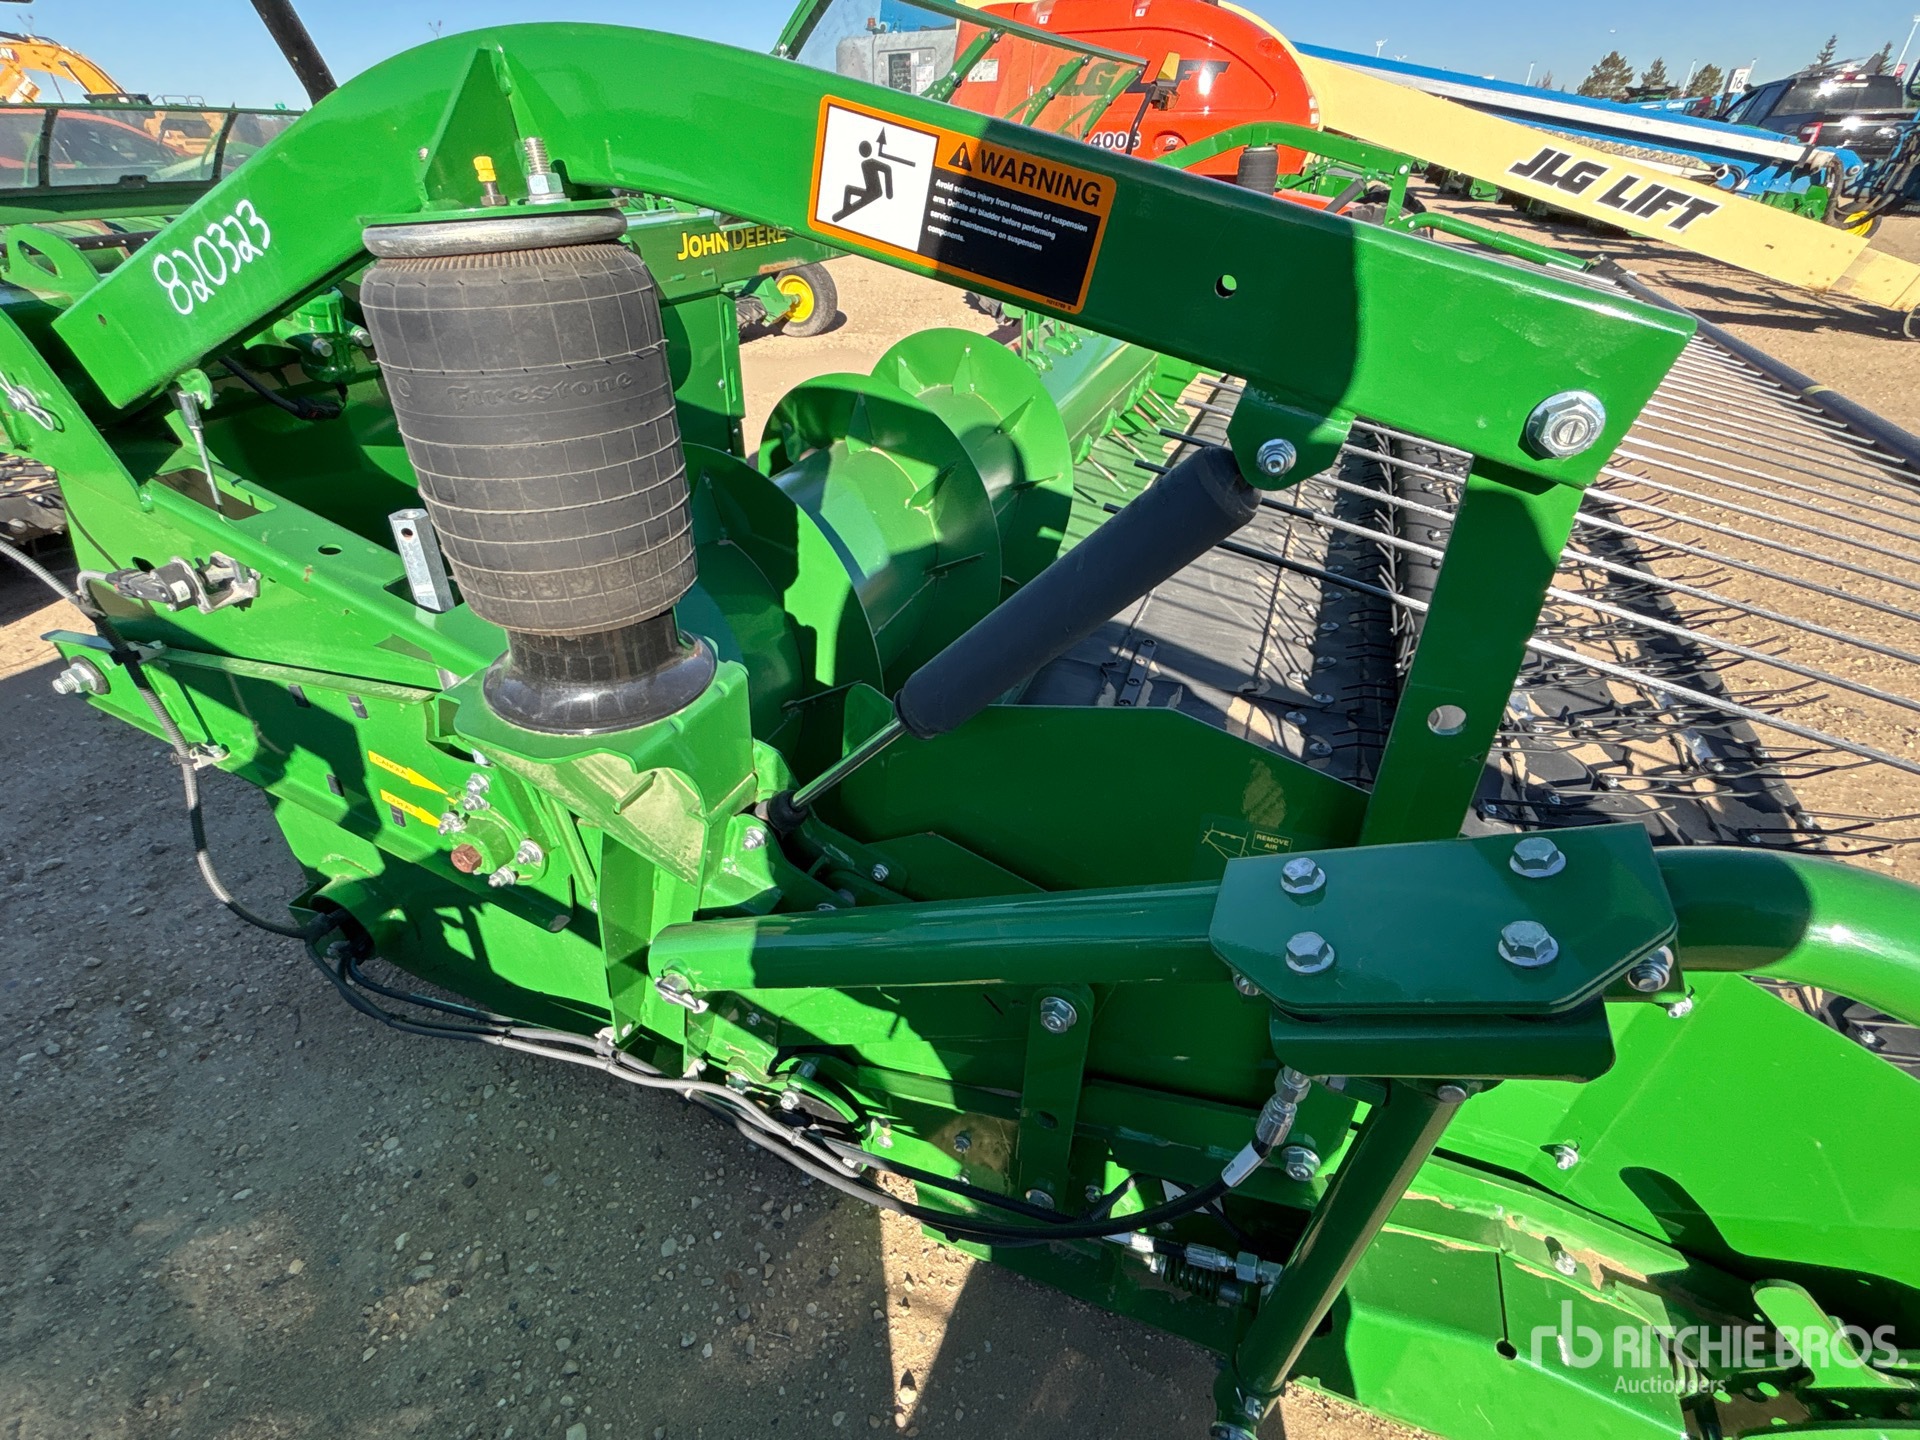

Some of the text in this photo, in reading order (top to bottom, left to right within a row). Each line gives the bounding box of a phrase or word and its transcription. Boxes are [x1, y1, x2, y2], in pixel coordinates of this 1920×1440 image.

[1732, 76, 1743, 89] 16
[981, 149, 1101, 207] WARNING
[1508, 147, 1721, 231] JLG LIFT
[932, 196, 1056, 240] arm. Deflate air bladder before performing
[936, 179, 1088, 232] Avoid serious injury from movement of suspension
[677, 226, 787, 261] JOHN DEERE
[927, 224, 965, 242] components.
[930, 210, 1042, 251] service or maintenance on suspension
[152, 198, 271, 315] 820323
[446, 371, 633, 410] Firestone
[1256, 833, 1289, 847] REMOVE
[1264, 843, 1278, 851] AIR
